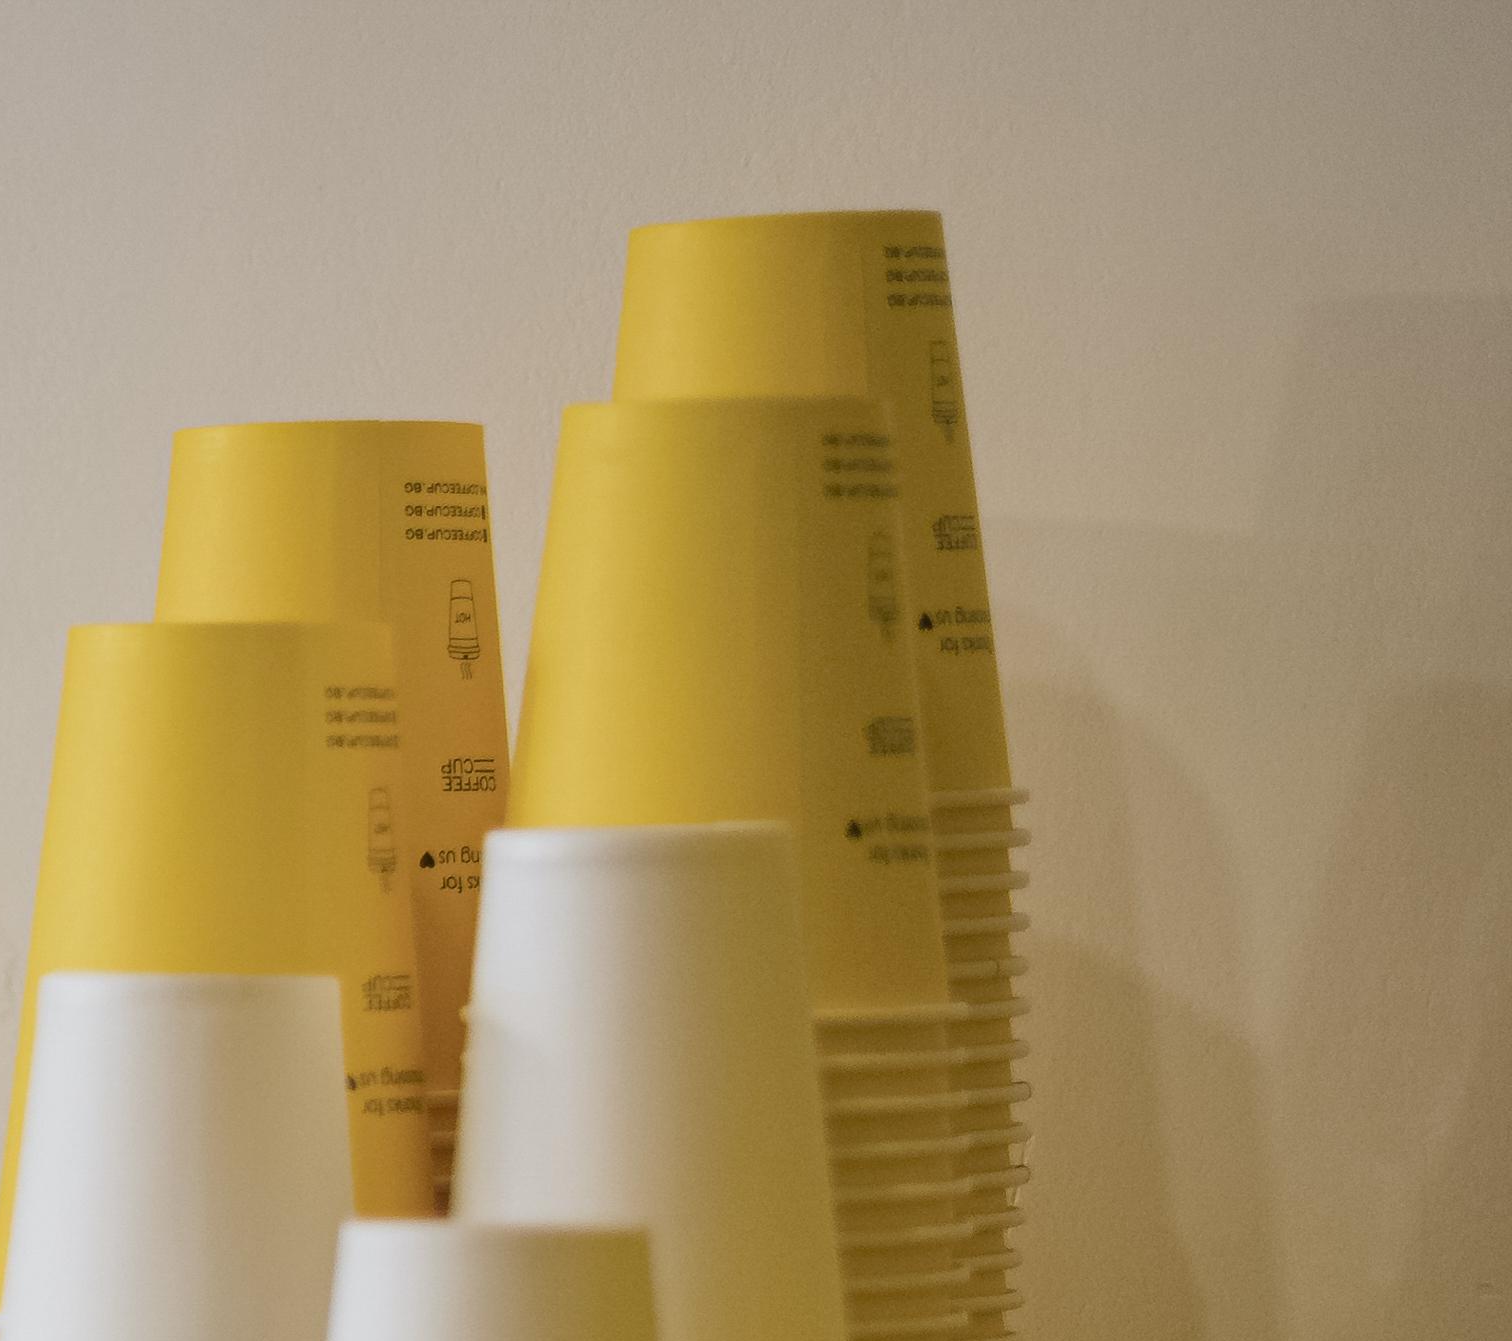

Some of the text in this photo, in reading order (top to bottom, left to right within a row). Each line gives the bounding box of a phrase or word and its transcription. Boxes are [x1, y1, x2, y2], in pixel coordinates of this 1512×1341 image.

[441, 758, 473, 774] CUP
[442, 776, 496, 792] COFFEE
[439, 850, 456, 864] us
[440, 876, 463, 894] for
